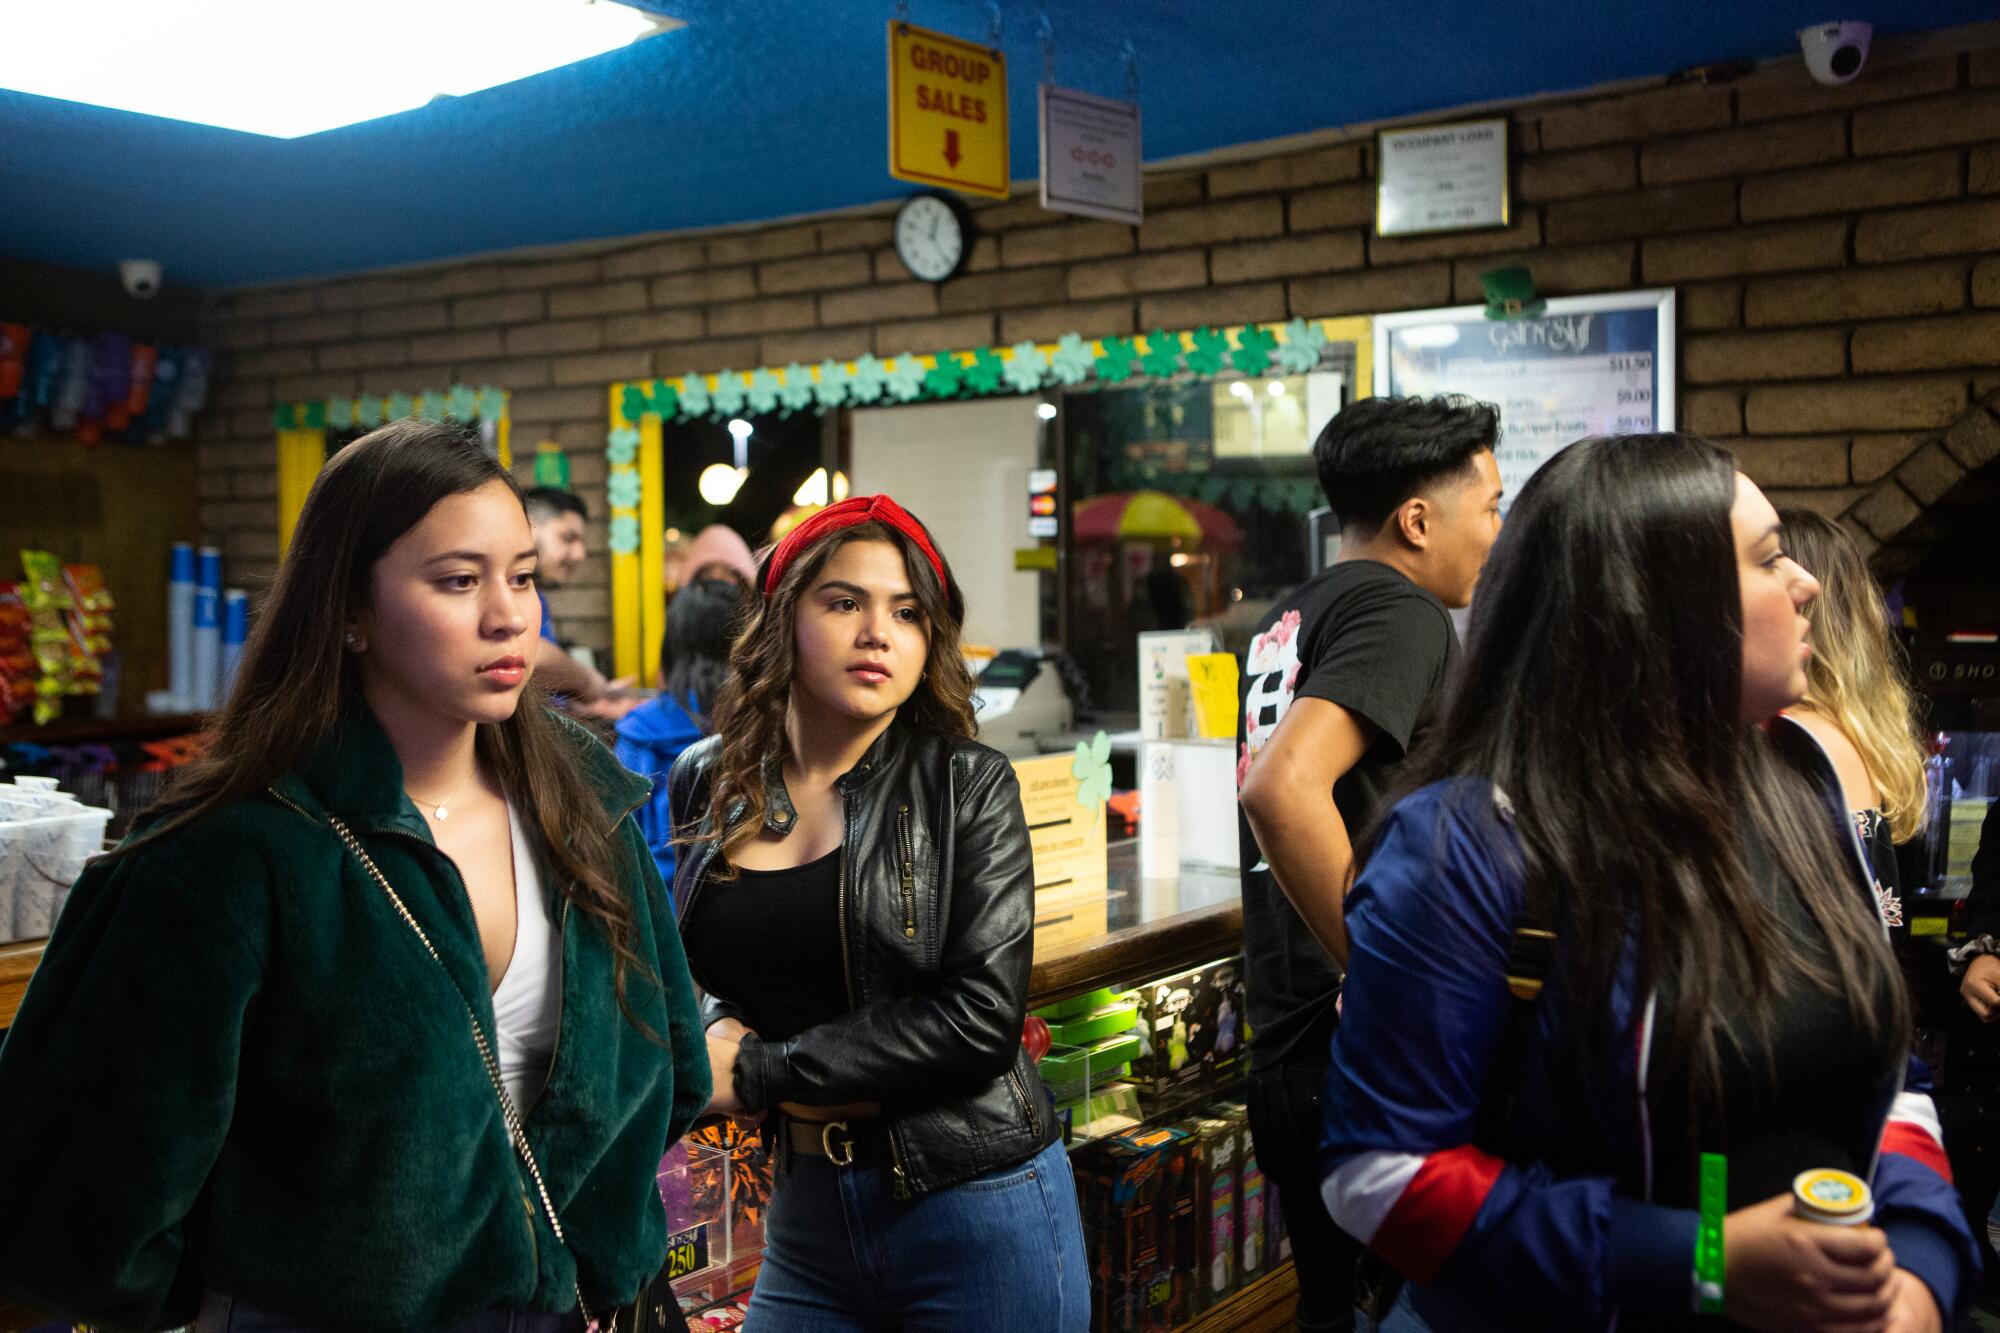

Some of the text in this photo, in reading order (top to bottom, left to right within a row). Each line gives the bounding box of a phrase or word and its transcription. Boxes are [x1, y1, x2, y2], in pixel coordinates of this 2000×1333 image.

[910, 45, 991, 86] GROUP
[916, 84, 988, 124] SALES
[822, 1121, 854, 1166] G
[668, 1243, 695, 1279] 250
